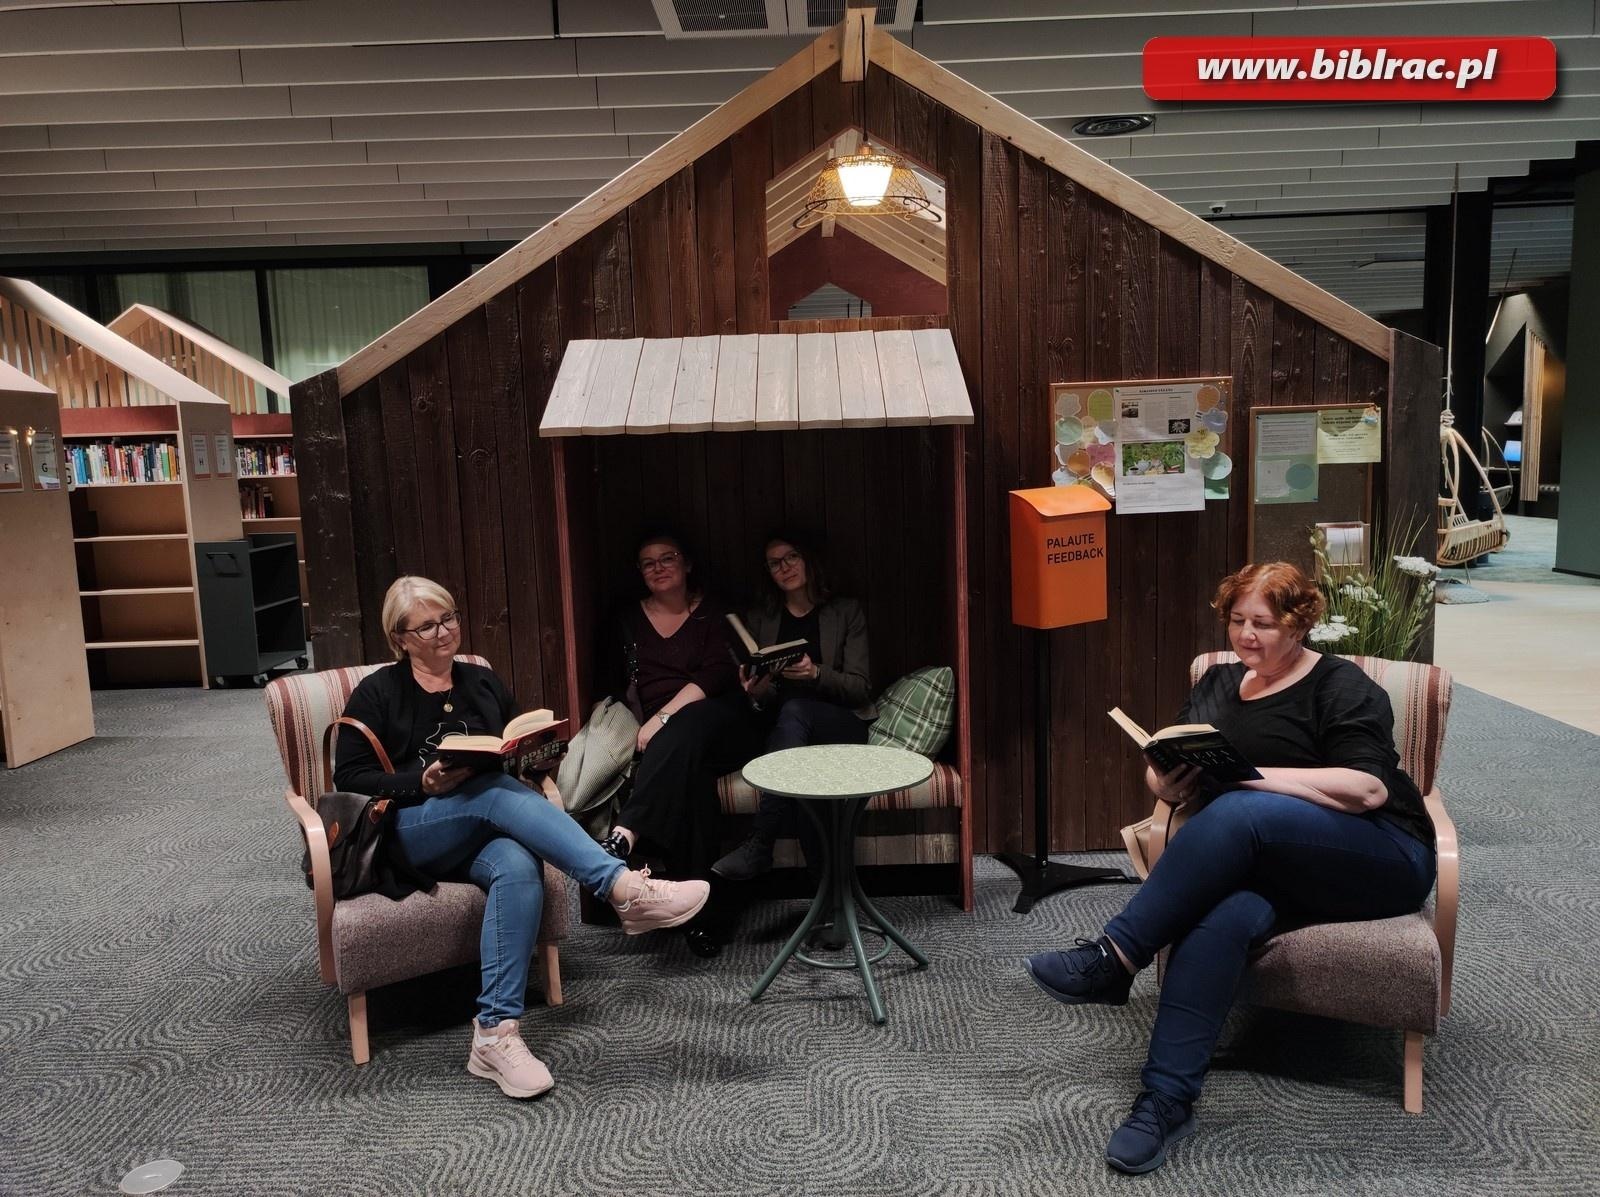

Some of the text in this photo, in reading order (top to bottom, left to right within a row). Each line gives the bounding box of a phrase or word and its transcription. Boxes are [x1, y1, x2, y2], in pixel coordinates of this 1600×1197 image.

[41, 463, 48, 473] G
[1047, 533, 1095, 548] PALAUTE
[1047, 547, 1104, 564] FEEDBACK
